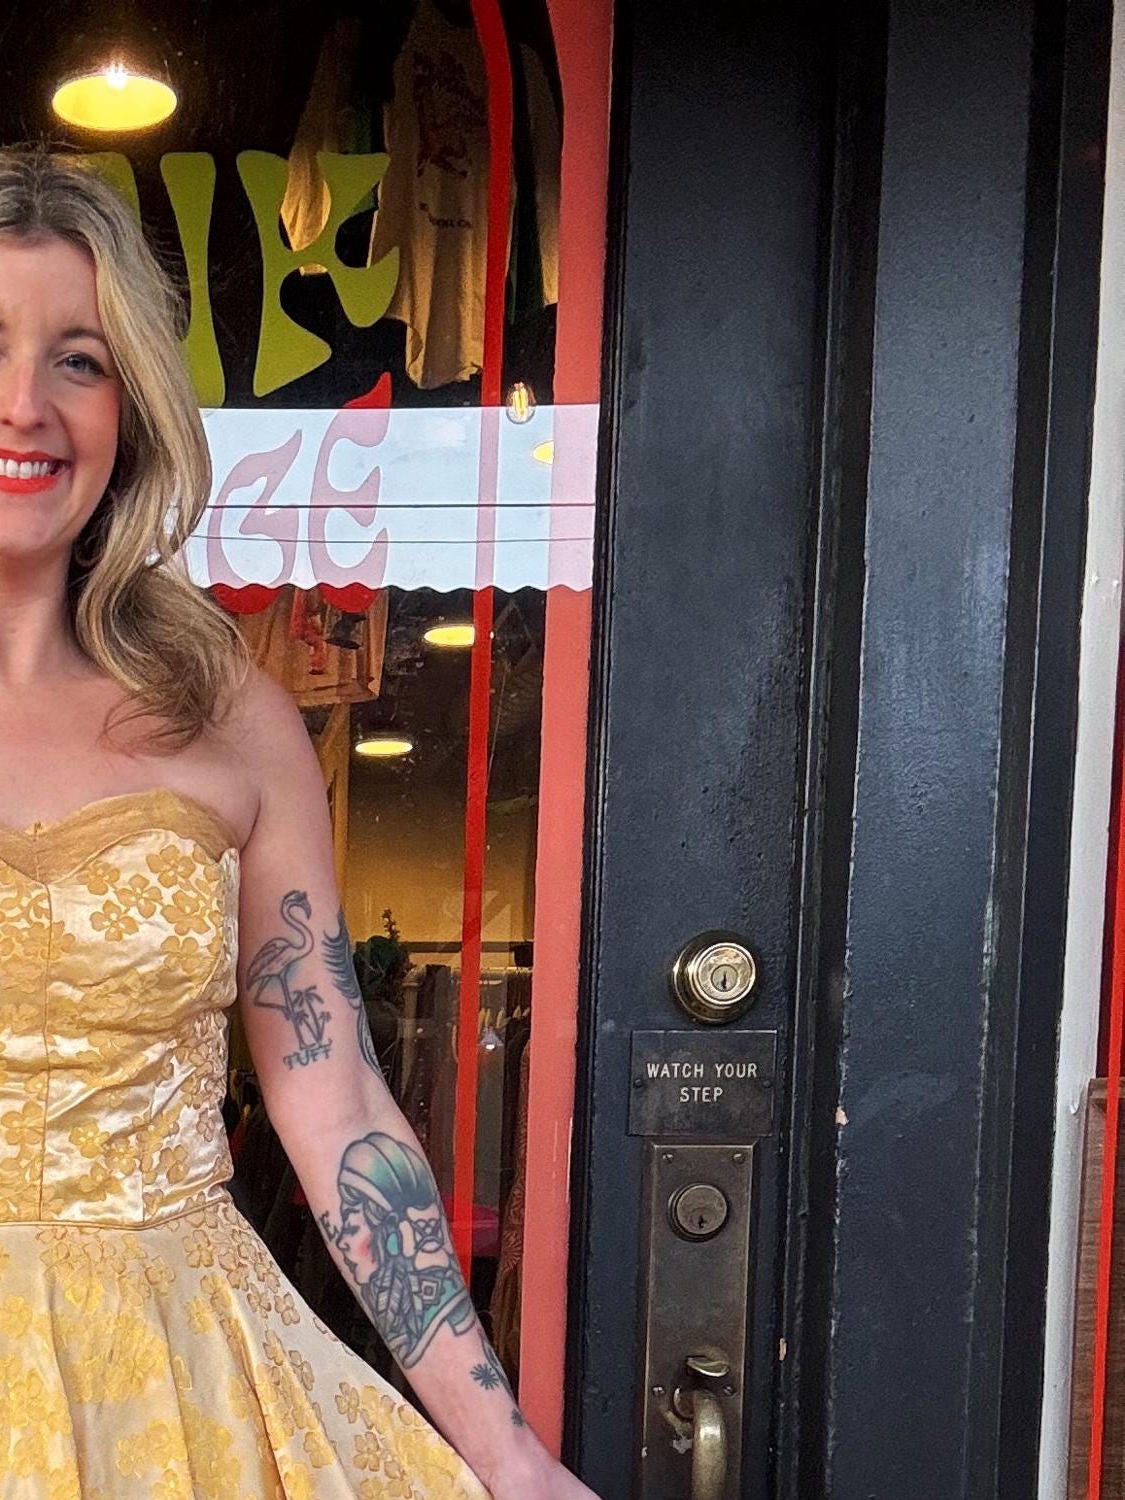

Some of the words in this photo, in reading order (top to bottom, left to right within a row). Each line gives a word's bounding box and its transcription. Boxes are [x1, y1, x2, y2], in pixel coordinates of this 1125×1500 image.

[646, 1062, 704, 1079] WATCH
[715, 1062, 758, 1079] YOUR
[679, 1086, 724, 1103] STEP
